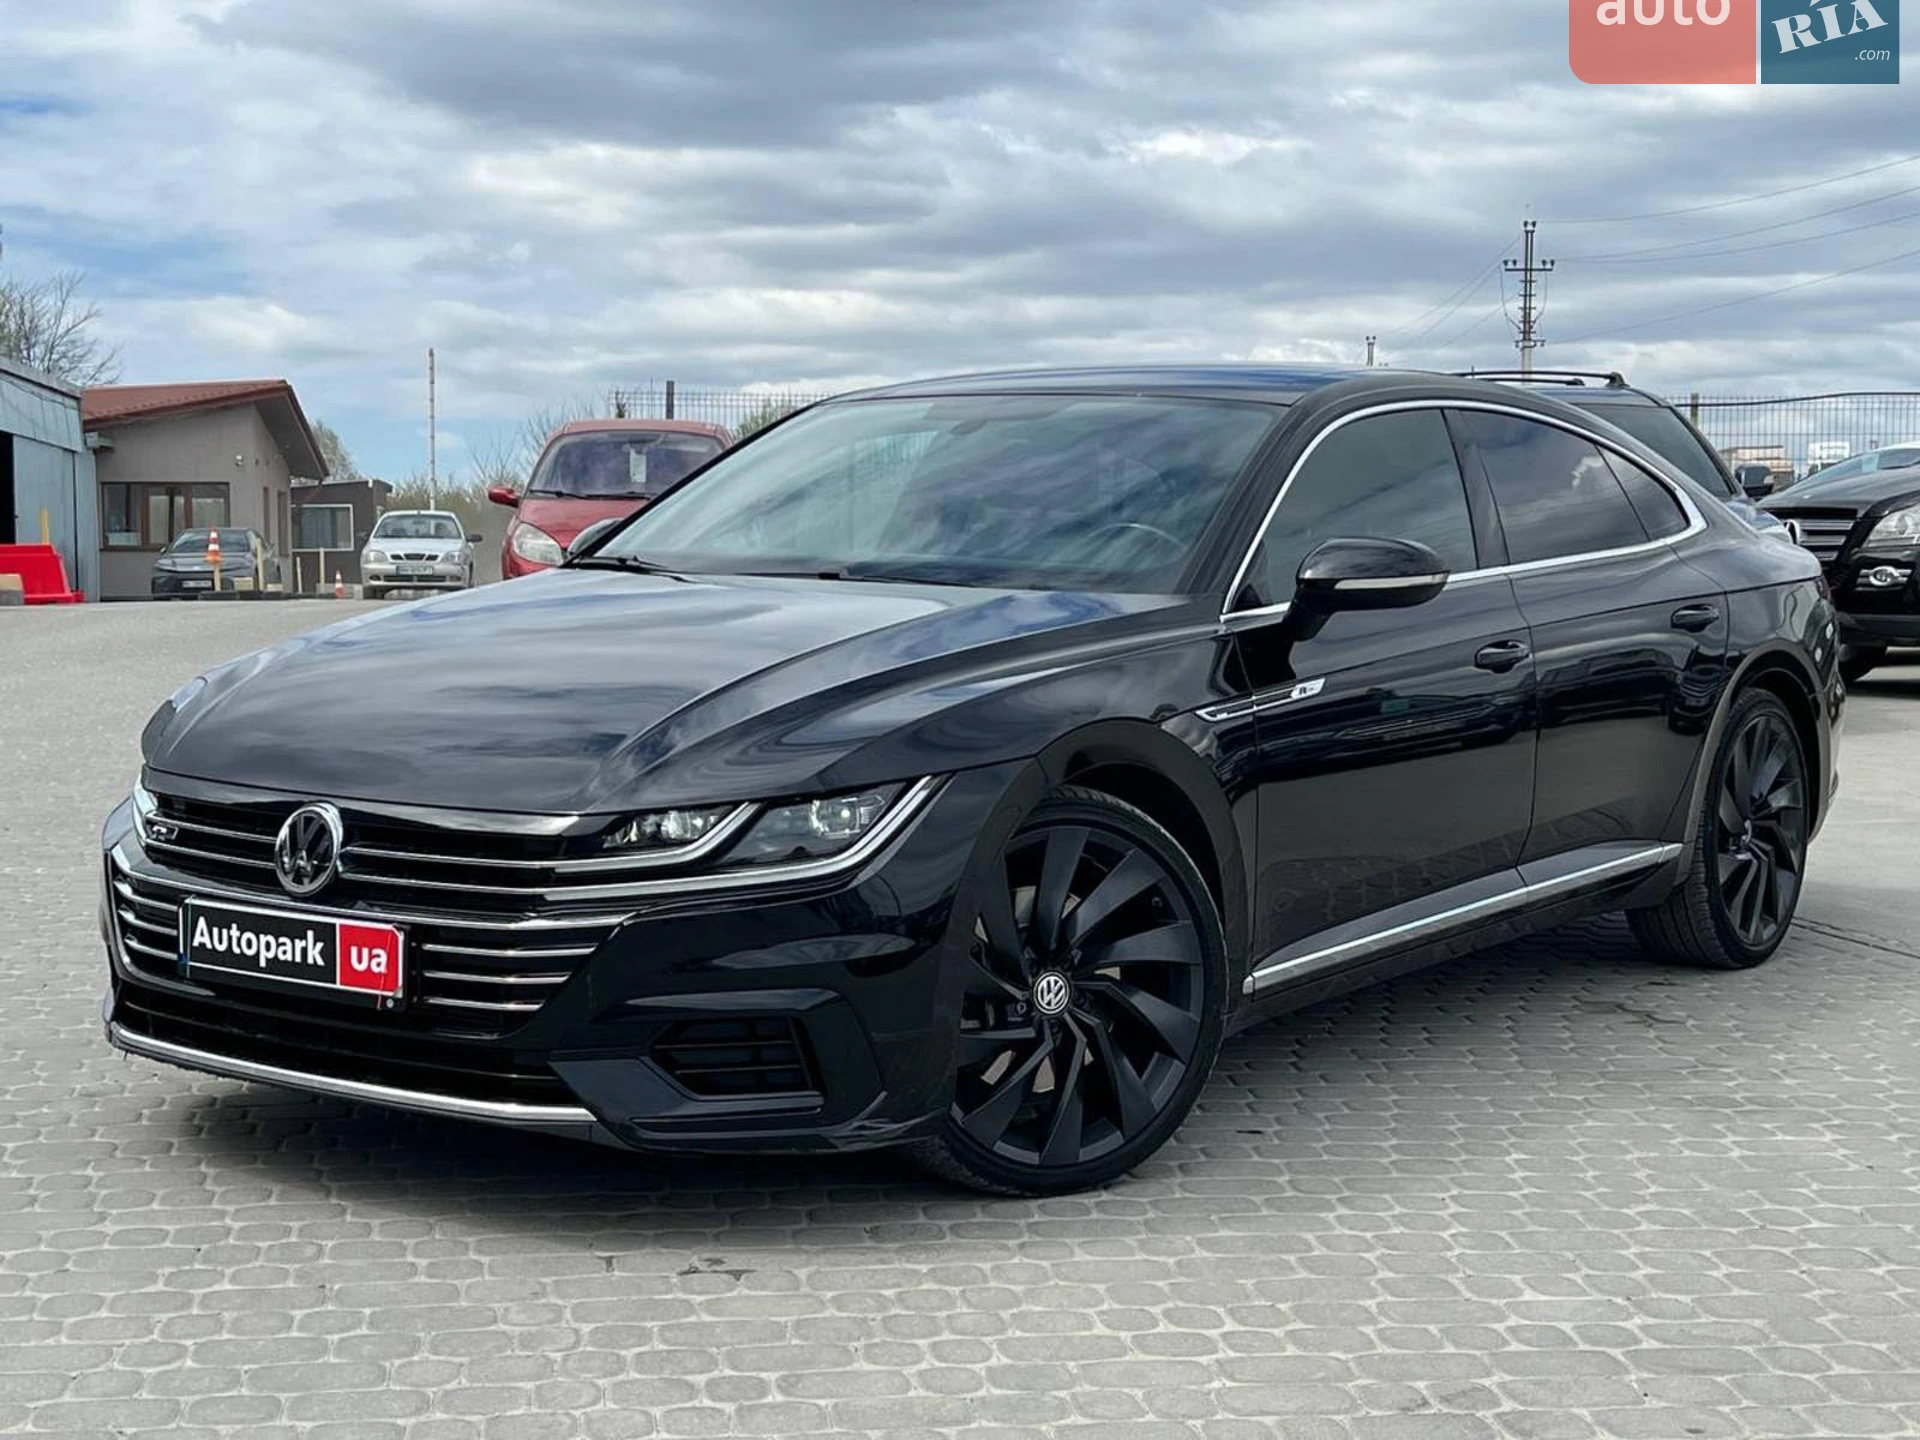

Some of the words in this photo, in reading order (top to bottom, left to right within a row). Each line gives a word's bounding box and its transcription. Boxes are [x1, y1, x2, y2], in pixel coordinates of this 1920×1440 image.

[192, 916, 325, 968] Autopark
[350, 945, 388, 973] ua
[1036, 974, 1067, 1011] VW
